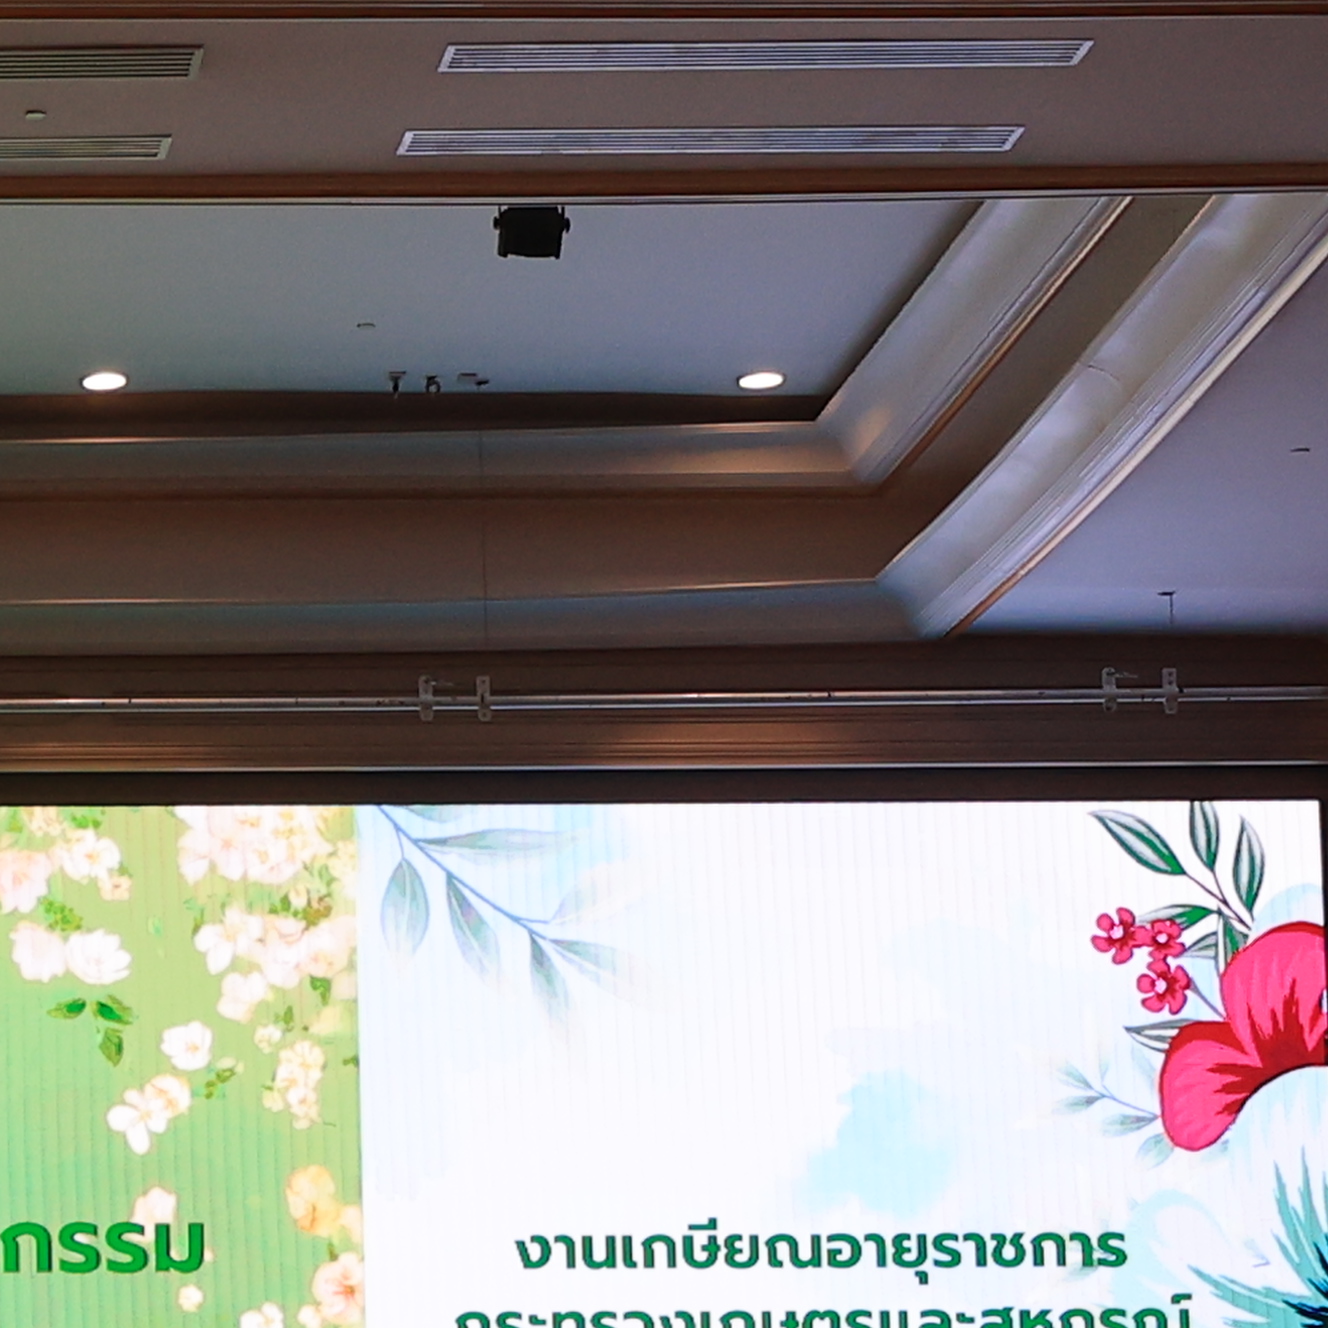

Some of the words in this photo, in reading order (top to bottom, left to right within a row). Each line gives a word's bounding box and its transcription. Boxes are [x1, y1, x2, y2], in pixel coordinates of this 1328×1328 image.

[515, 1217, 1128, 1285] งานเกษียณอายุราชการ
